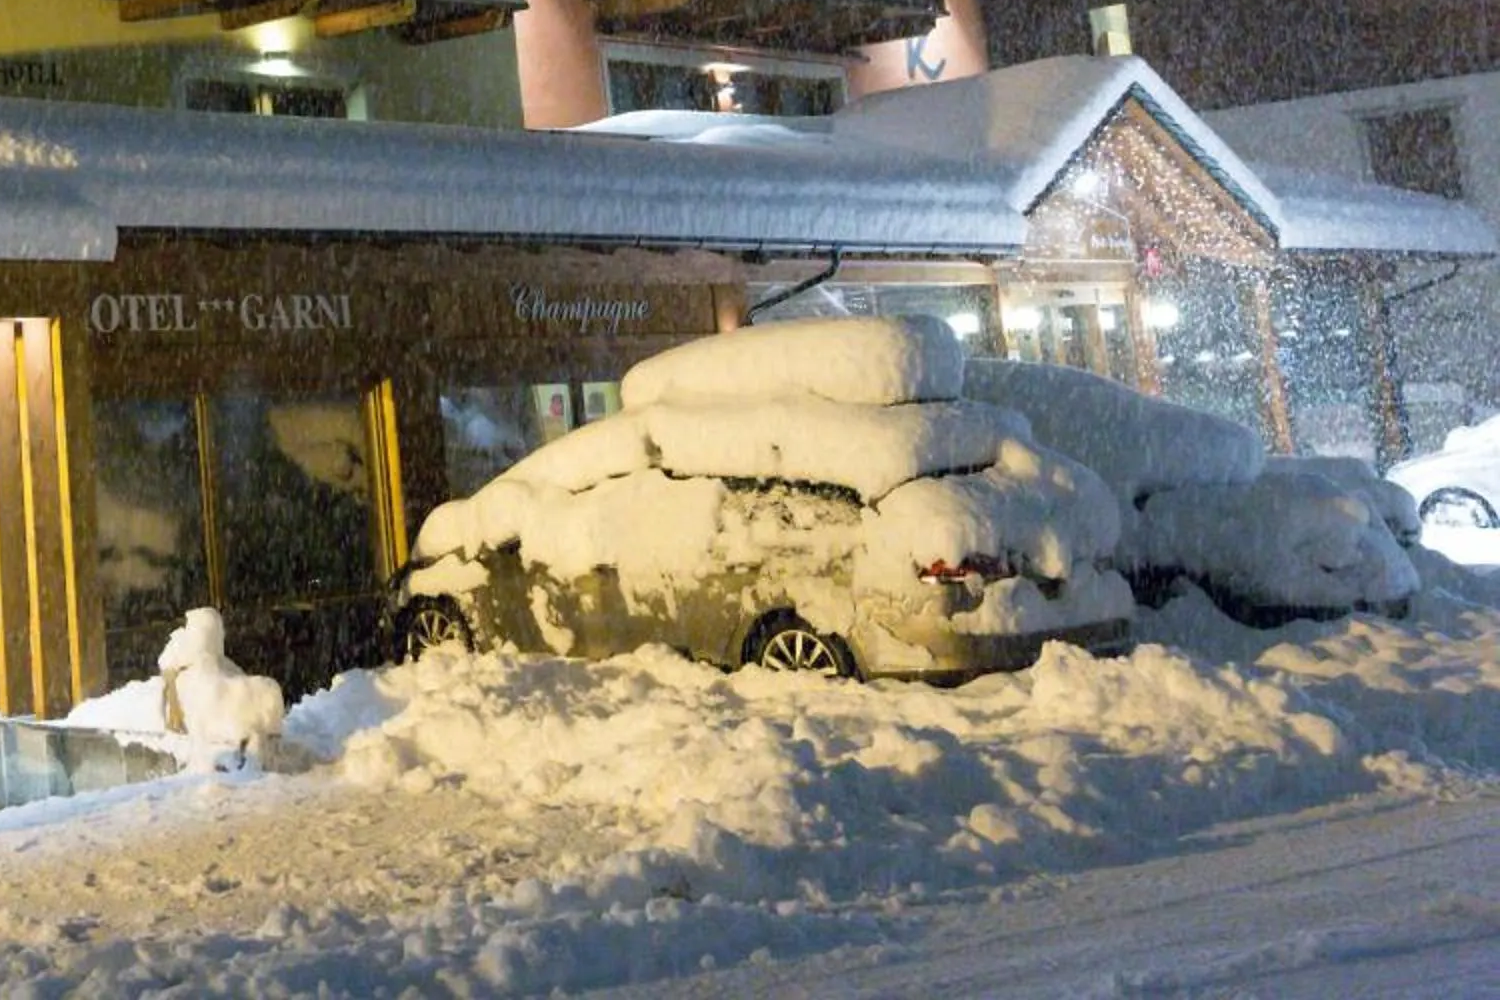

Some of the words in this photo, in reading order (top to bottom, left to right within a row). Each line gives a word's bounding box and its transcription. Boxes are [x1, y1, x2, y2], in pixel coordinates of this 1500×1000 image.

[87, 293, 198, 332] OTEL
[240, 294, 353, 330] GARNI
[509, 280, 651, 334] Champagne
